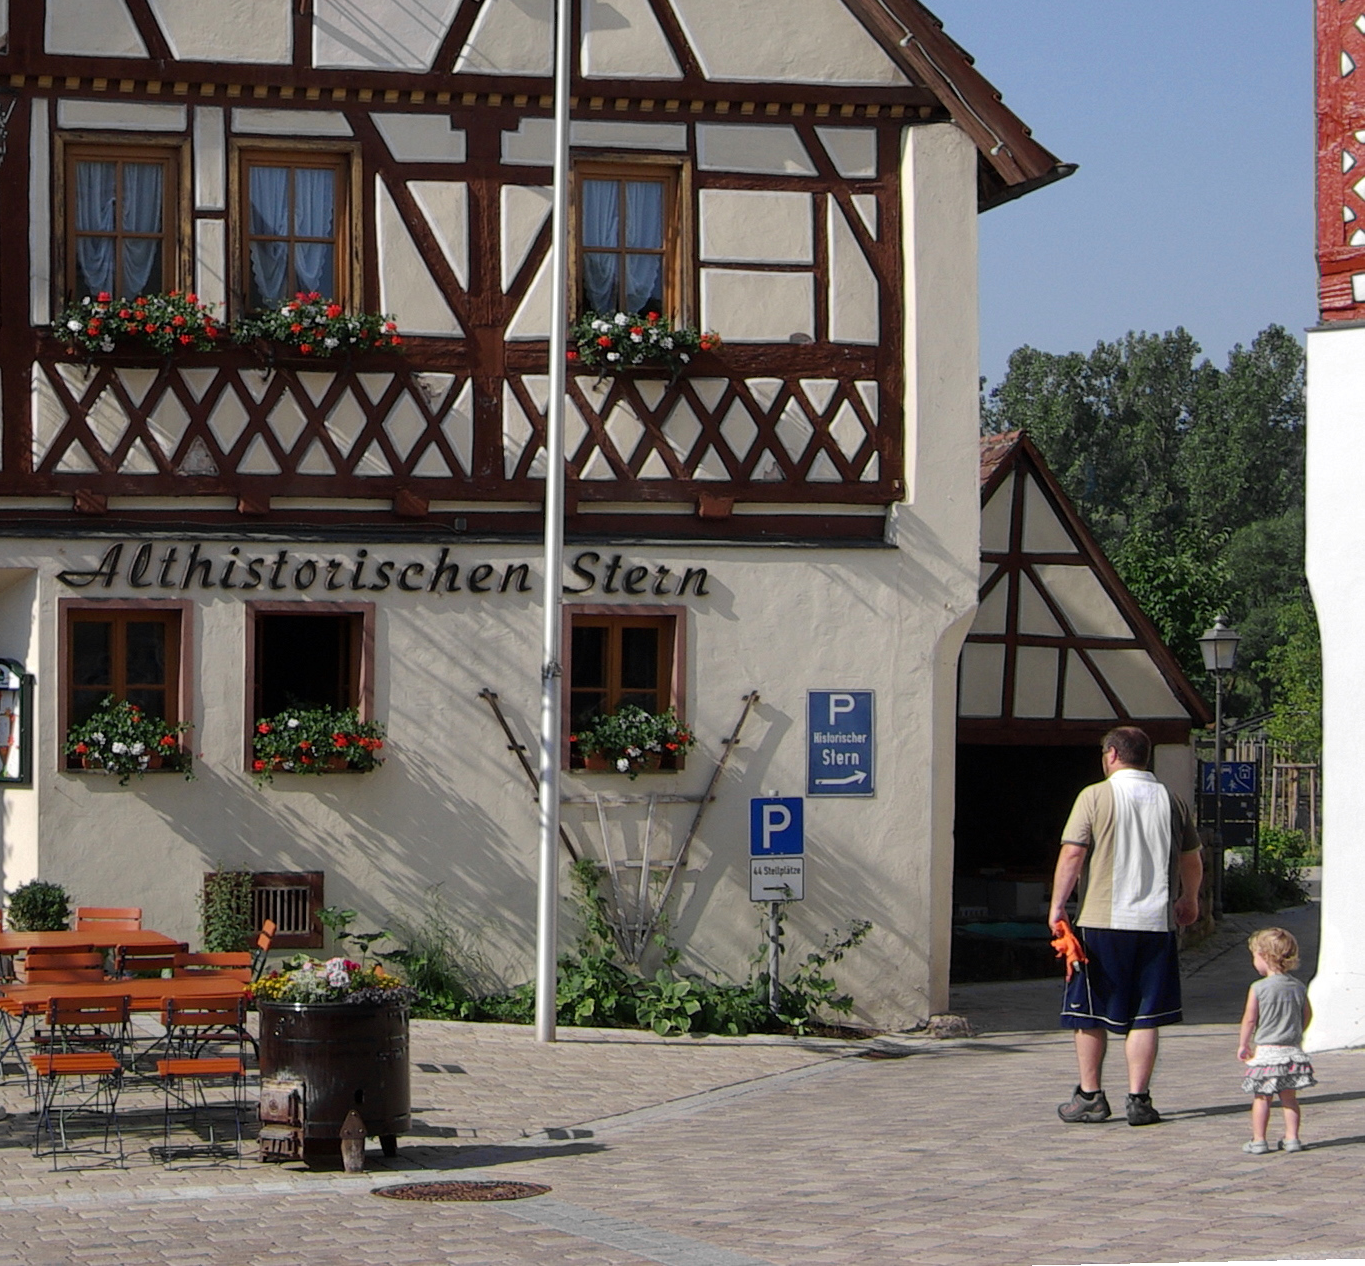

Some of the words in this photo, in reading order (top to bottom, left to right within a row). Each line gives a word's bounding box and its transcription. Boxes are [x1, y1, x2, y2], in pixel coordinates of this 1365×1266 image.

[55, 542, 532, 593] Althistorischen
[562, 551, 710, 596] Stern
[829, 694, 855, 725] P
[813, 732, 867, 744] Historischer
[822, 749, 860, 765] Stern
[763, 804, 792, 849] P
[753, 867, 762, 875] 44
[763, 866, 801, 877] Stellplätze
